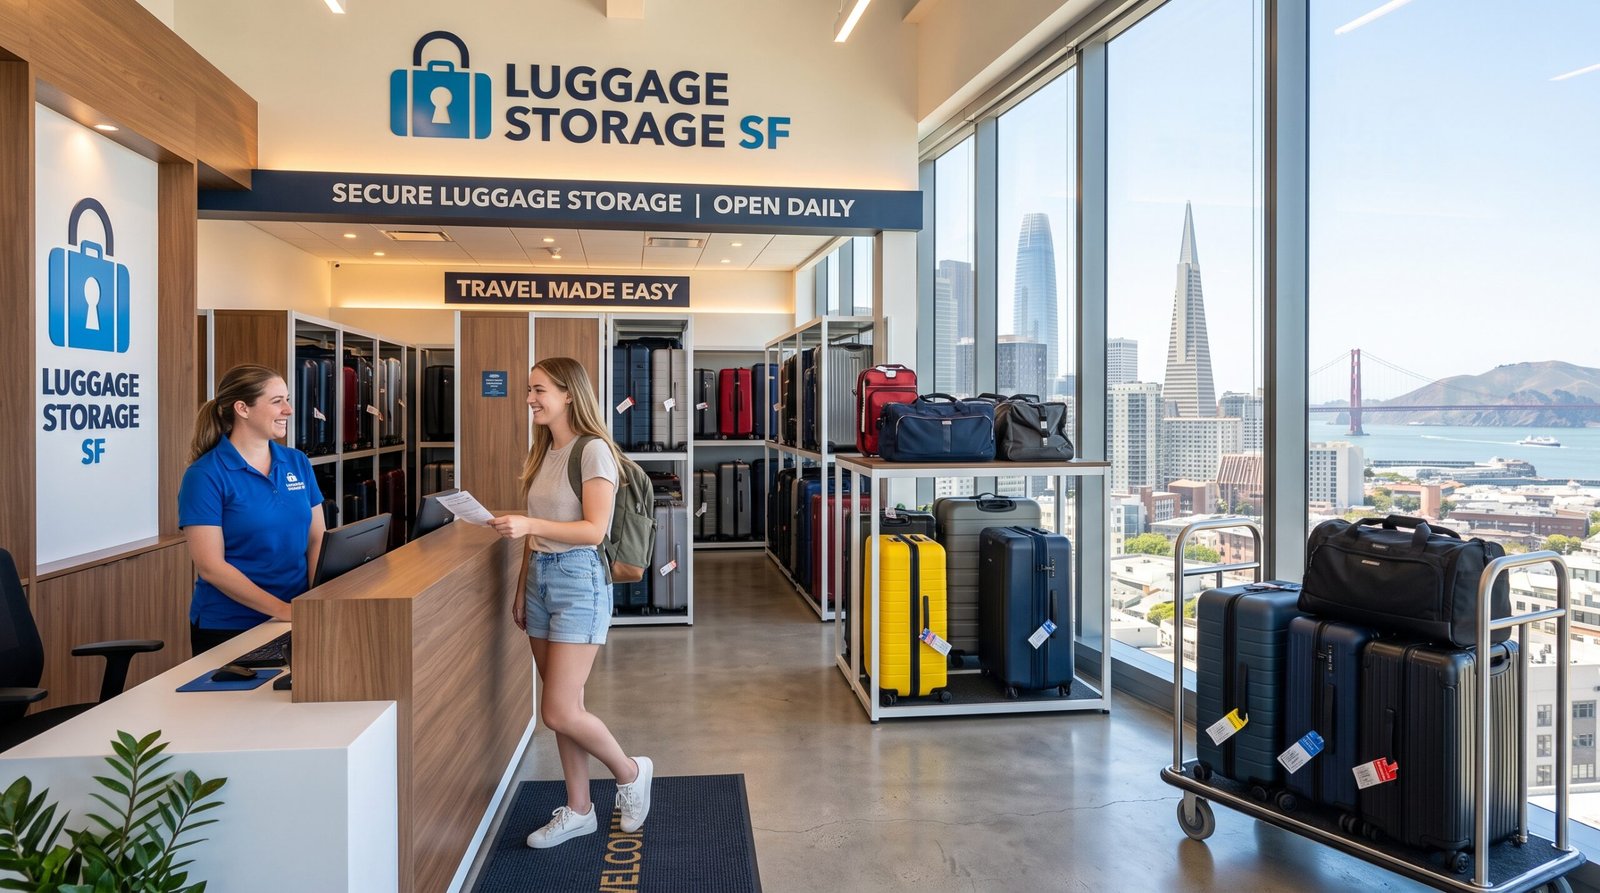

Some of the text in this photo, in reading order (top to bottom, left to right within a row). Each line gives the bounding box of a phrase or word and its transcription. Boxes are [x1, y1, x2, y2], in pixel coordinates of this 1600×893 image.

[506, 63, 729, 106] LUGGAGE
[504, 106, 791, 149] STORAGE SF
[332, 183, 433, 205] SECURE
[440, 187, 561, 209] LUGGAGE
[567, 191, 682, 212] STORAGE
[713, 195, 780, 215] OPEN
[787, 198, 856, 217] DAILY
[456, 279, 679, 300] TRAVEL MADE EASY
[42, 368, 140, 398] LUGGAGE
[42, 404, 140, 432] STORAGE
[81, 438, 106, 465] SF
[599, 811, 643, 893] ELCO
